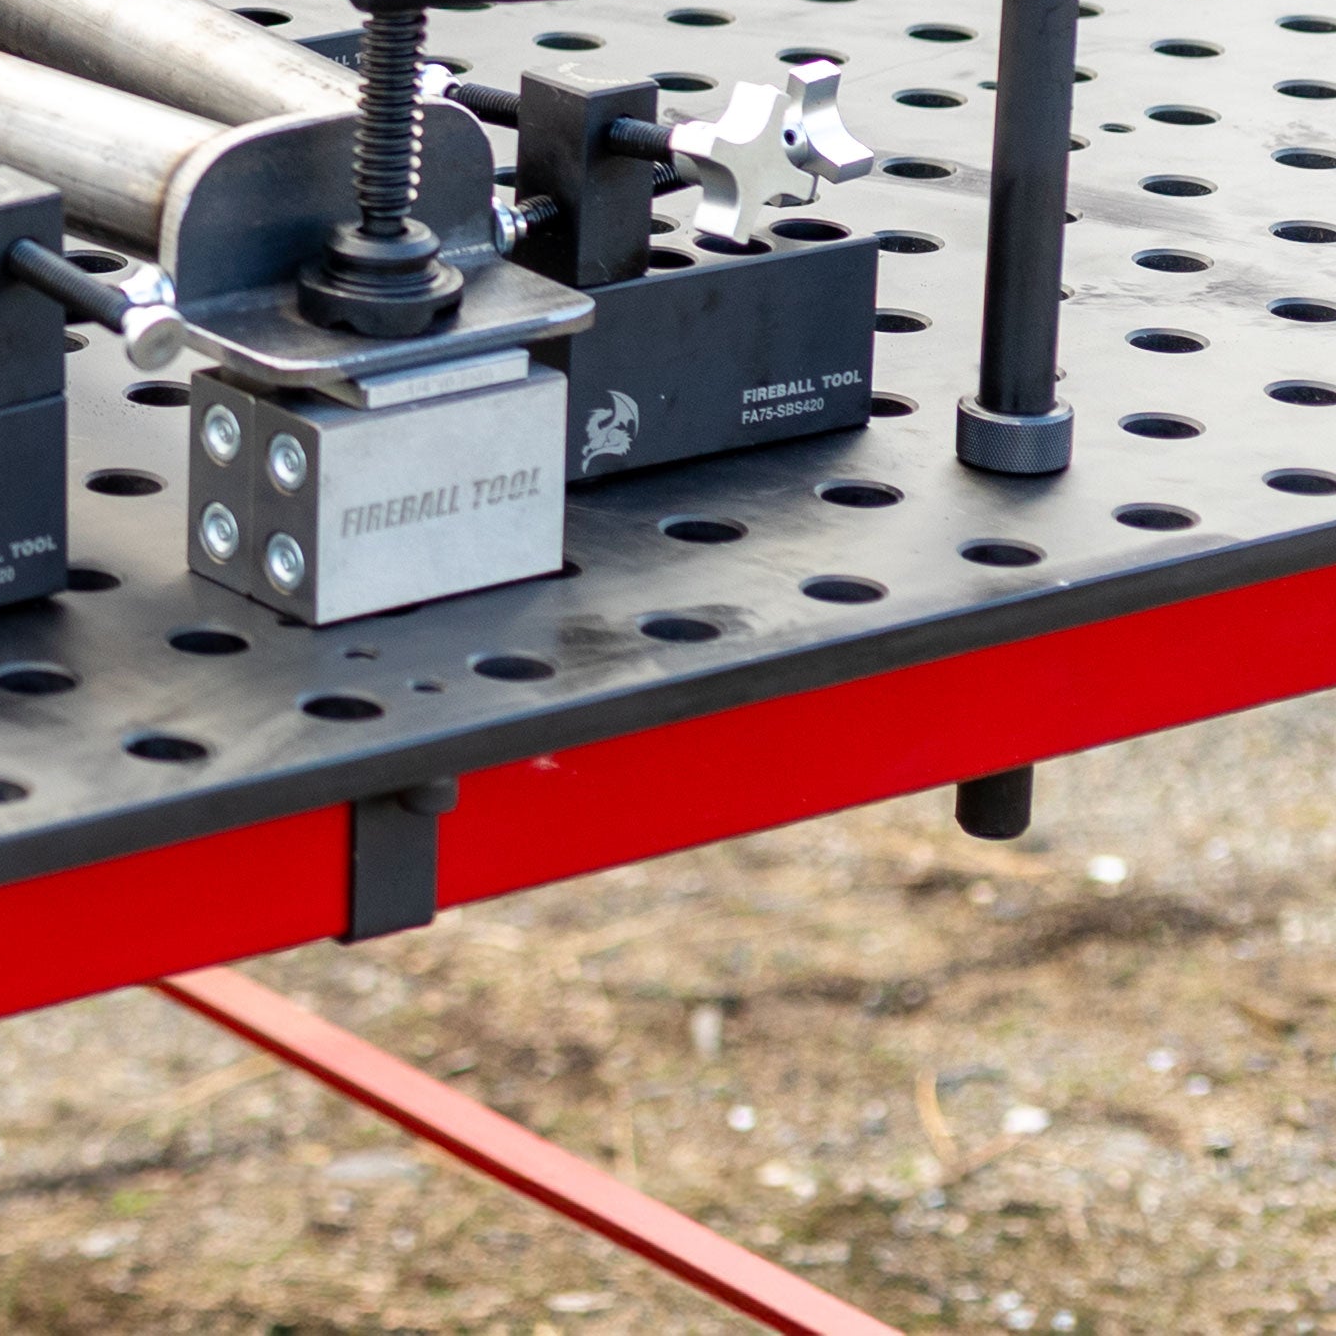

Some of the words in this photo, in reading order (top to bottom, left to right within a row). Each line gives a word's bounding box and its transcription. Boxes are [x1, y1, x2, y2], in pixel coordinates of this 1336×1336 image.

[742, 378, 816, 405] FIREBALL
[821, 370, 863, 389] TOOL
[741, 397, 825, 425] FA75-SBS420
[340, 485, 460, 539] FIREBALL
[471, 467, 542, 511] TOOL
[9, 534, 58, 560] TOOL
